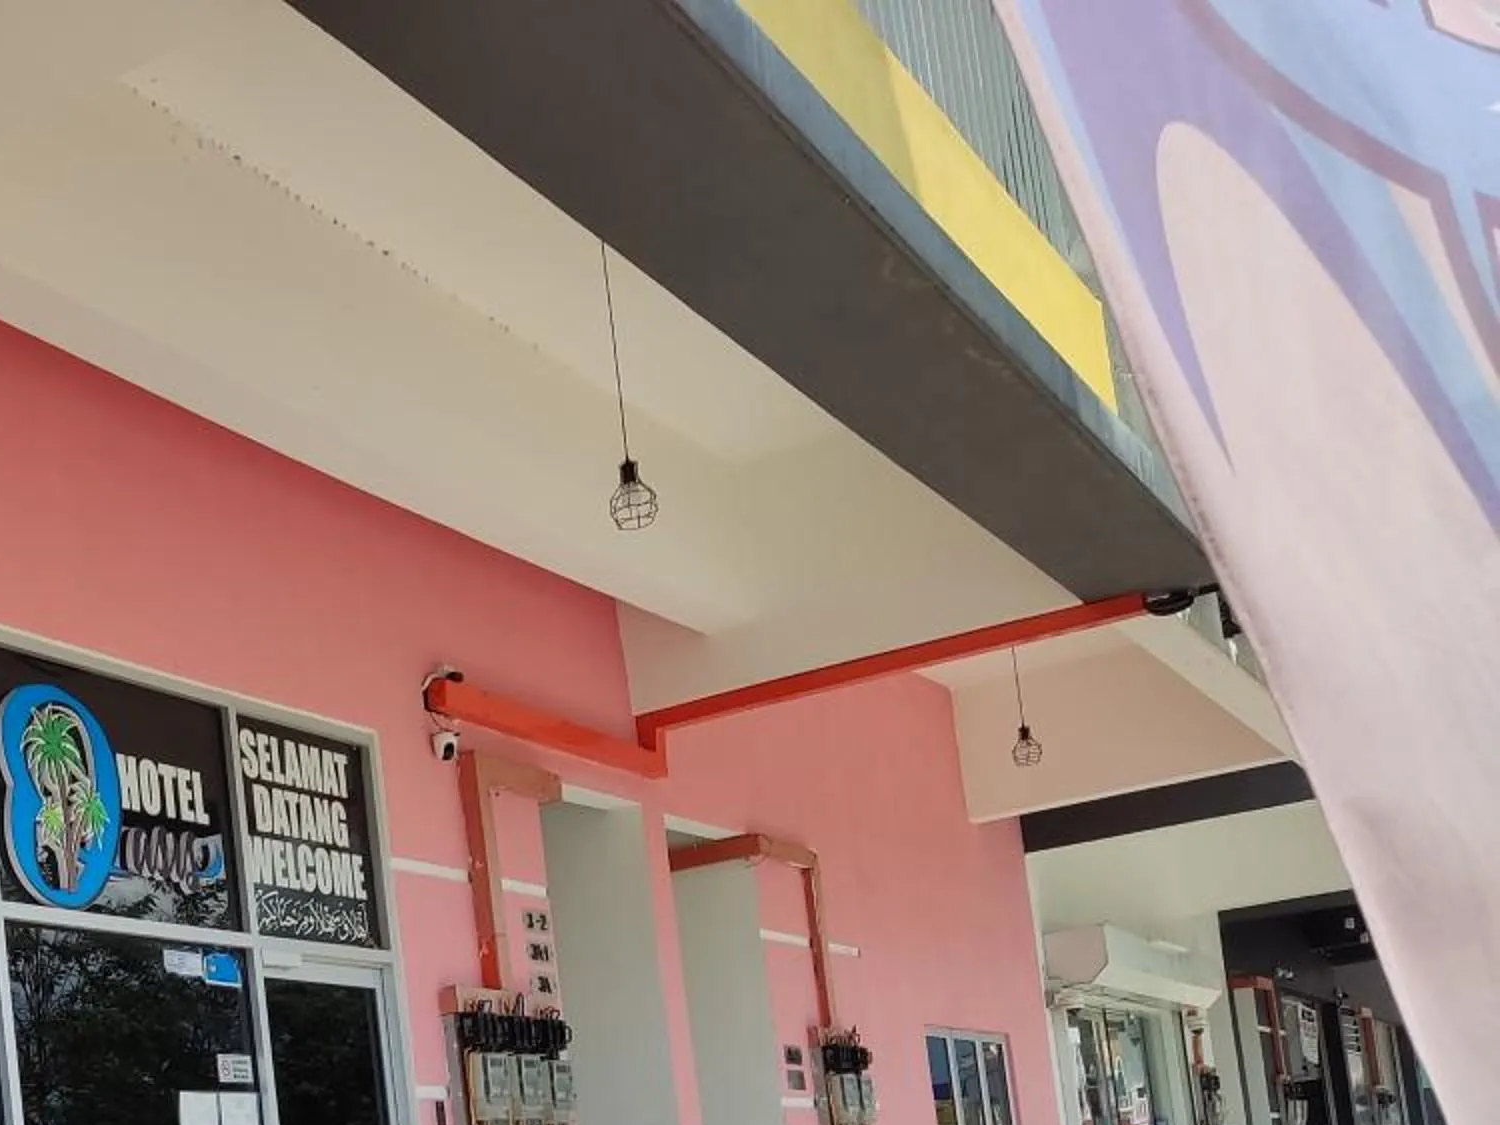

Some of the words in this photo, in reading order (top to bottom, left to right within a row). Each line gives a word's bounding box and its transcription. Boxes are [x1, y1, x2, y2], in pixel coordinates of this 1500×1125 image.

[116, 752, 211, 826] HOTEL
[239, 727, 349, 799] SELAMAT
[251, 783, 350, 849] DATANG
[246, 835, 369, 901] WELCOME
